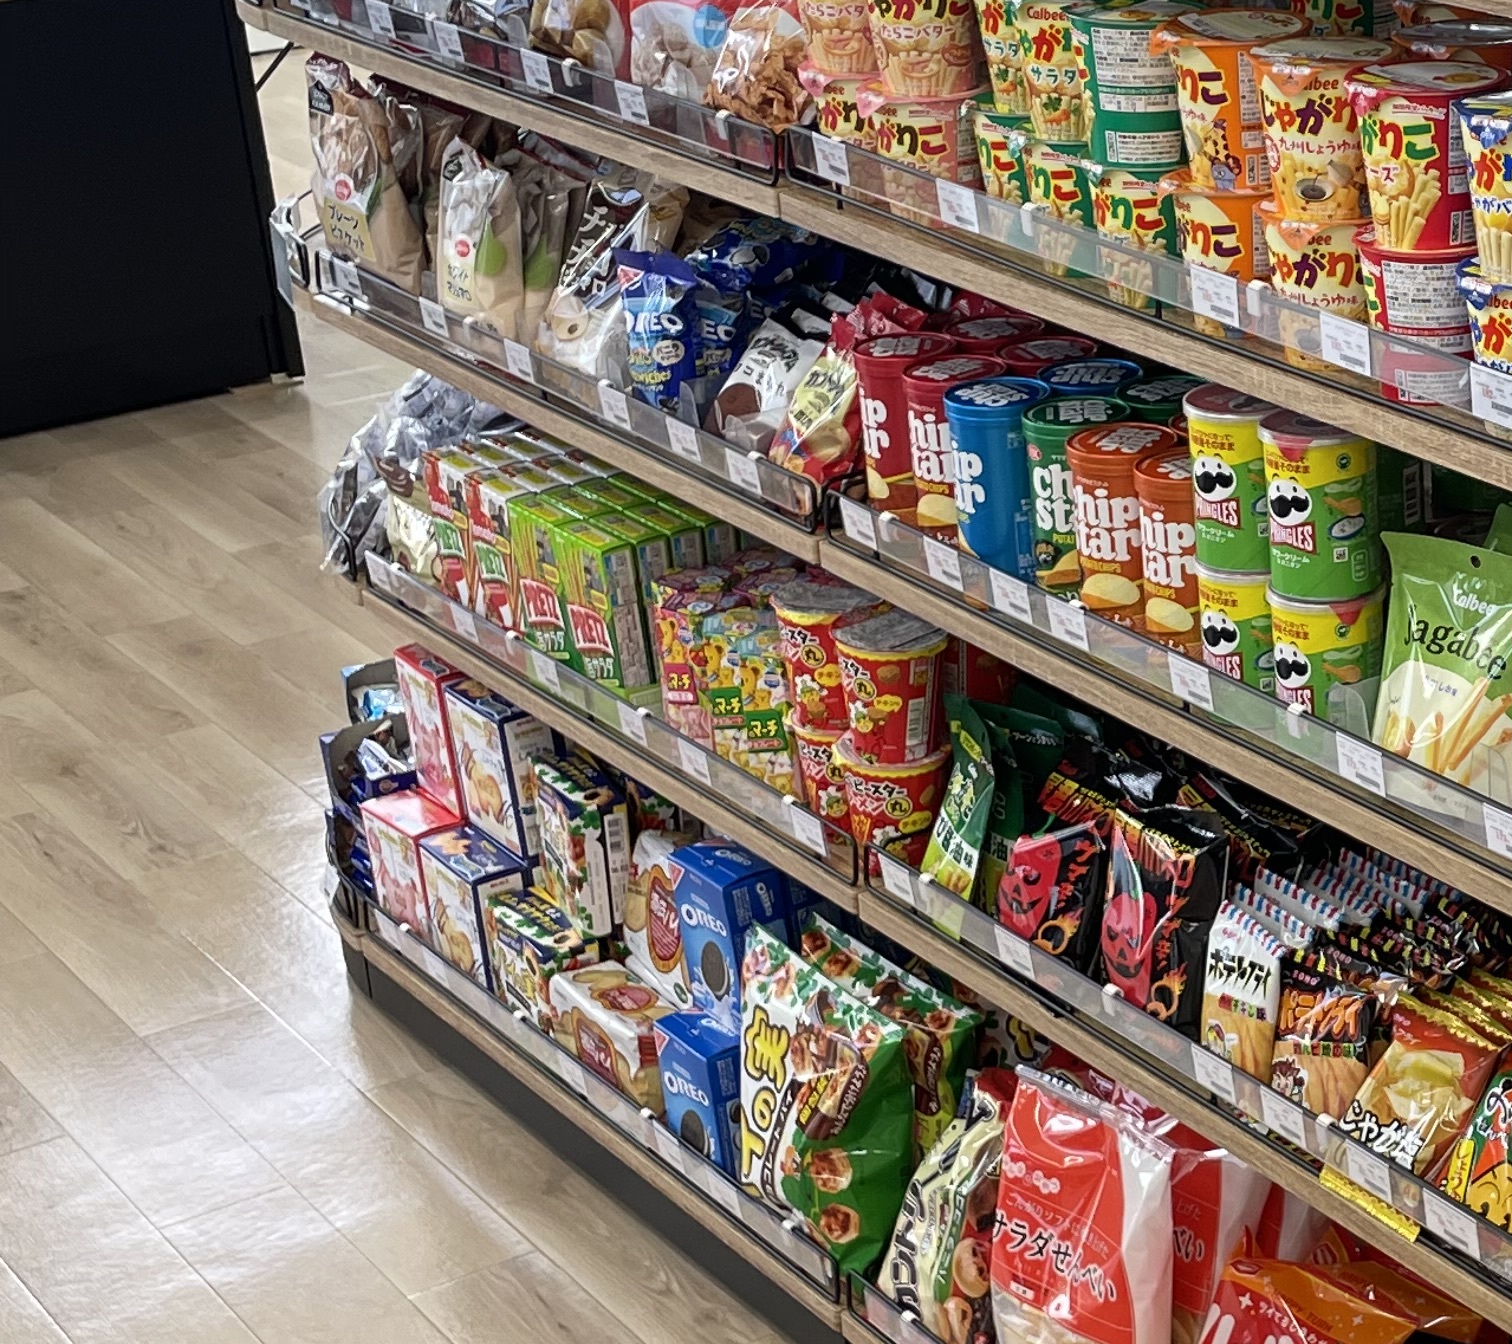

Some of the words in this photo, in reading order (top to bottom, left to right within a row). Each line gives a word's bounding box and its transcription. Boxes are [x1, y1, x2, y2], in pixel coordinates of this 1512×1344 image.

[1075, 484, 1142, 529] hip
[681, 903, 727, 939] OREO
[662, 1068, 709, 1106] OREO
[991, 1209, 1119, 1302] サラダせんべい
